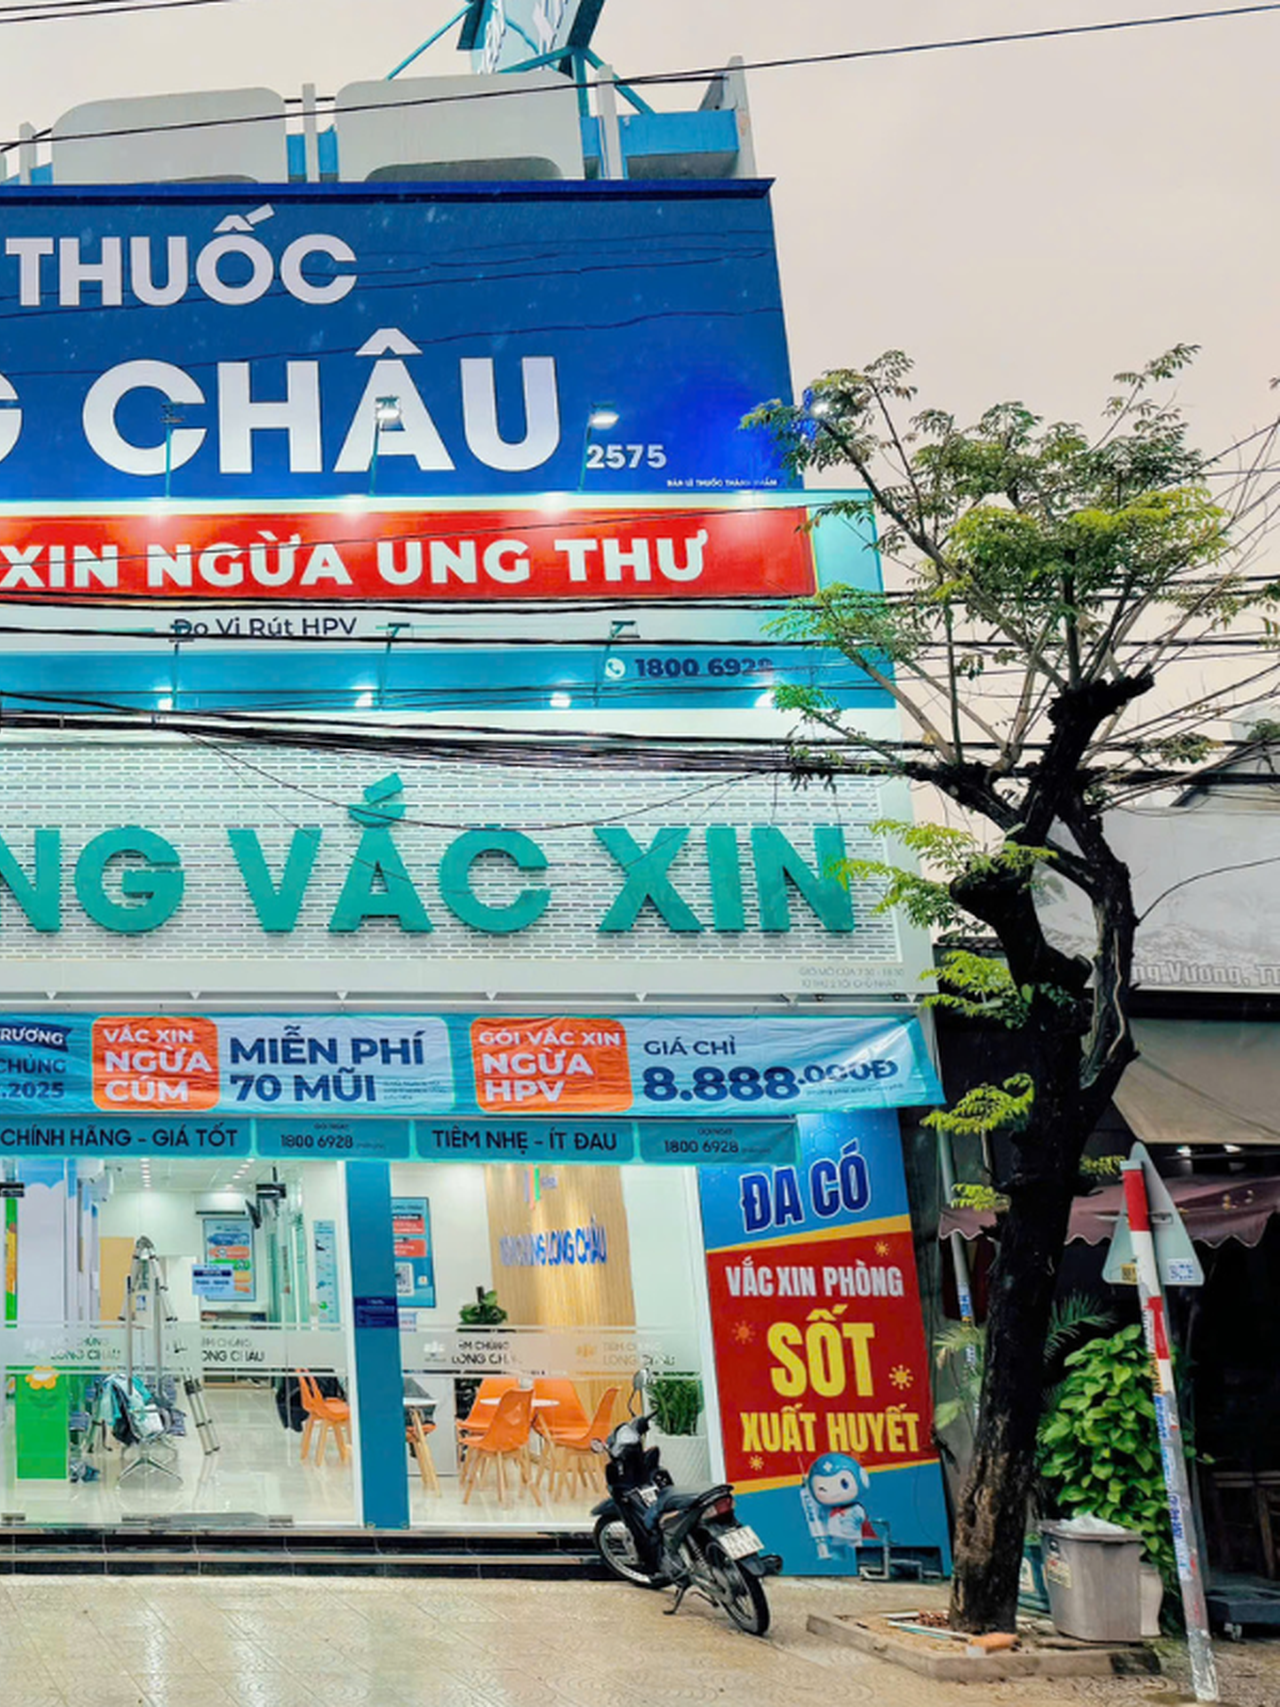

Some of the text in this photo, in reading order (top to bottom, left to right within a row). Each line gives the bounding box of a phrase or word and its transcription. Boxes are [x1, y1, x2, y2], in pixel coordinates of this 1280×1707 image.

[5, 203, 358, 306] THUỐC
[82, 328, 560, 475] CHÂU
[586, 444, 667, 469] 2575
[146, 530, 352, 587] NGỪA
[377, 539, 530, 586] UNG
[554, 528, 709, 583] THƯ
[216, 617, 240, 635] Vi
[249, 617, 294, 637] Rút
[302, 617, 357, 635] HPV
[635, 658, 699, 677] 1800
[227, 772, 550, 935] VẮC
[593, 825, 855, 933] XIN
[156, 1029, 194, 1043] XIN
[230, 1025, 425, 1065] MIỄN PHÍ
[582, 1032, 620, 1046] XIN
[643, 1036, 736, 1056] GIÁ CHỈ
[105, 1044, 212, 1073] NGỪA
[482, 1047, 594, 1075] NGỪA
[104, 1074, 188, 1102] CÚM
[230, 1074, 282, 1102] 70
[294, 1066, 376, 1102] MŨI
[484, 1080, 565, 1103] HPV
[0, 1122, 64, 1147] CHÍNH
[68, 1122, 132, 1147] HÃNG
[158, 1122, 191, 1147] GIÁ
[195, 1120, 238, 1147] TỐT
[280, 1134, 314, 1148] 1800
[317, 1134, 353, 1149] 6928
[432, 1125, 480, 1149] TIÊM
[486, 1130, 528, 1155] NHẸ
[549, 1126, 567, 1150] ÍT
[574, 1132, 617, 1150] ĐAU
[664, 1139, 698, 1153] 1800
[702, 1139, 739, 1154] 6928
[809, 1140, 870, 1218] CÓ
[725, 1256, 904, 1298] VẮC XIN PHÒNG
[202, 1350, 227, 1362] ONG
[767, 1304, 875, 1398] SỐT
[740, 1403, 919, 1453] XUẤT HUYẾT
